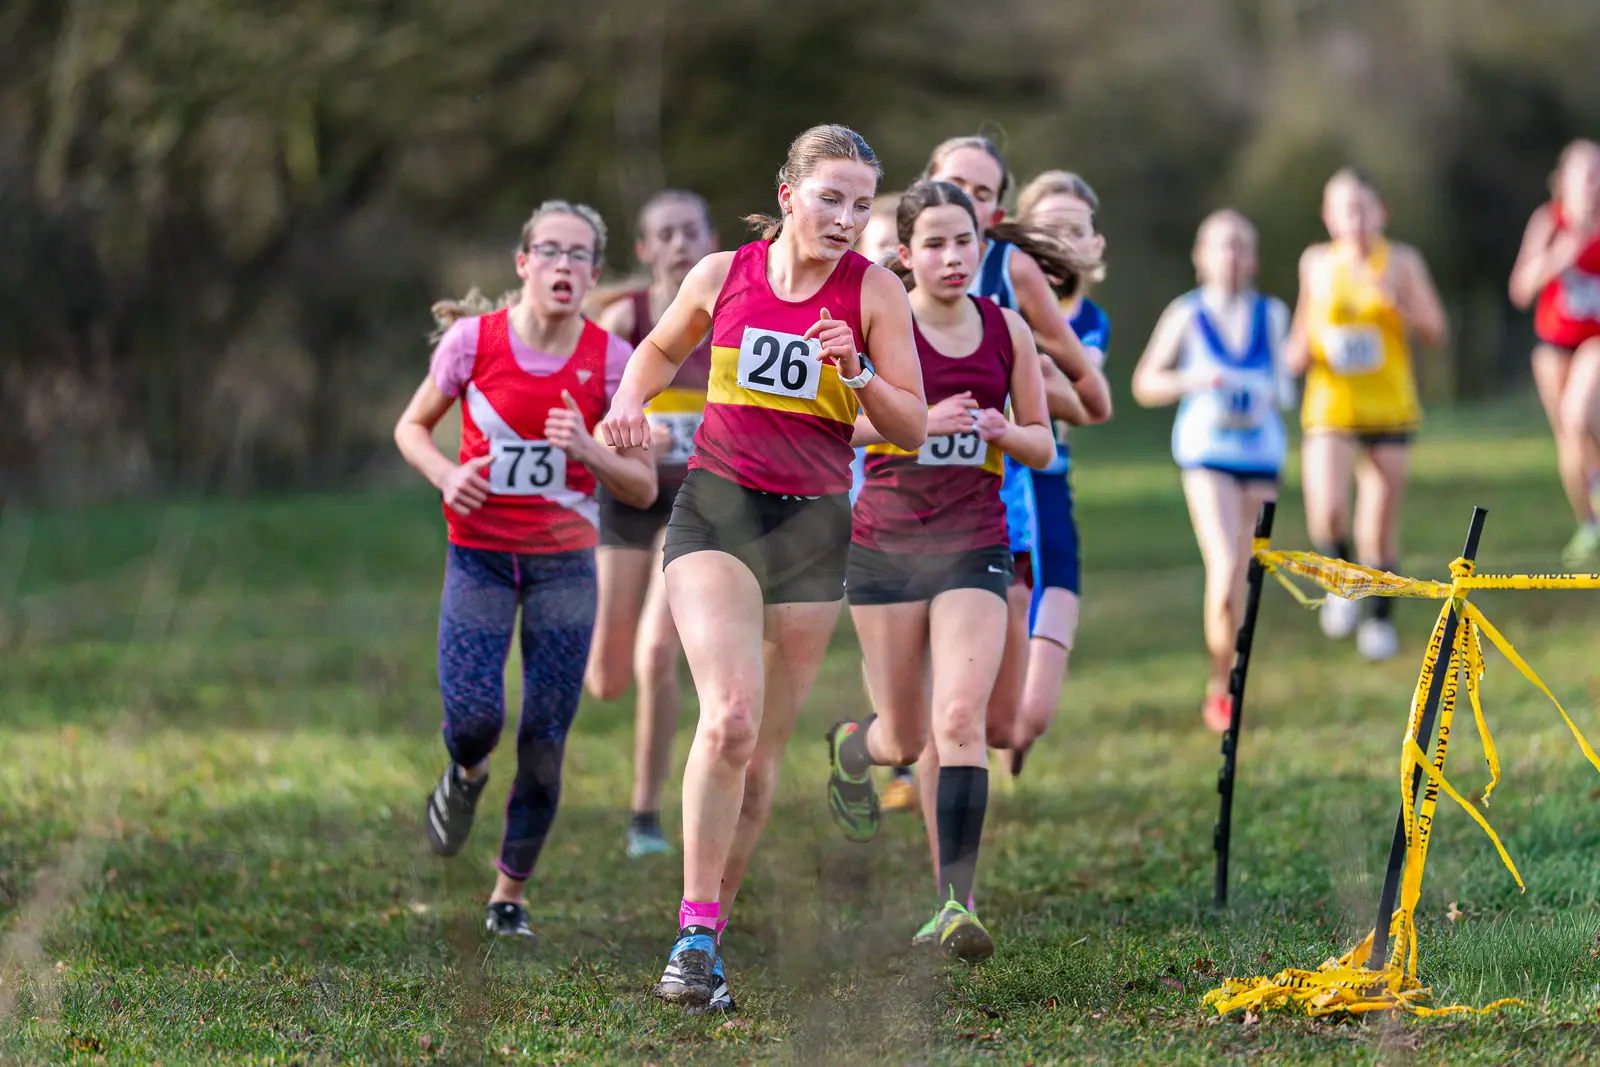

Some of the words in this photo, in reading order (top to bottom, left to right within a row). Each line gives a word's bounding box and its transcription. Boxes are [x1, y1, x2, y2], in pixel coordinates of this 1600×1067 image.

[748, 335, 810, 391] 26
[502, 446, 554, 488] 73
[1443, 635, 1459, 712] AUTION
[1424, 726, 1450, 802] CAUTN
